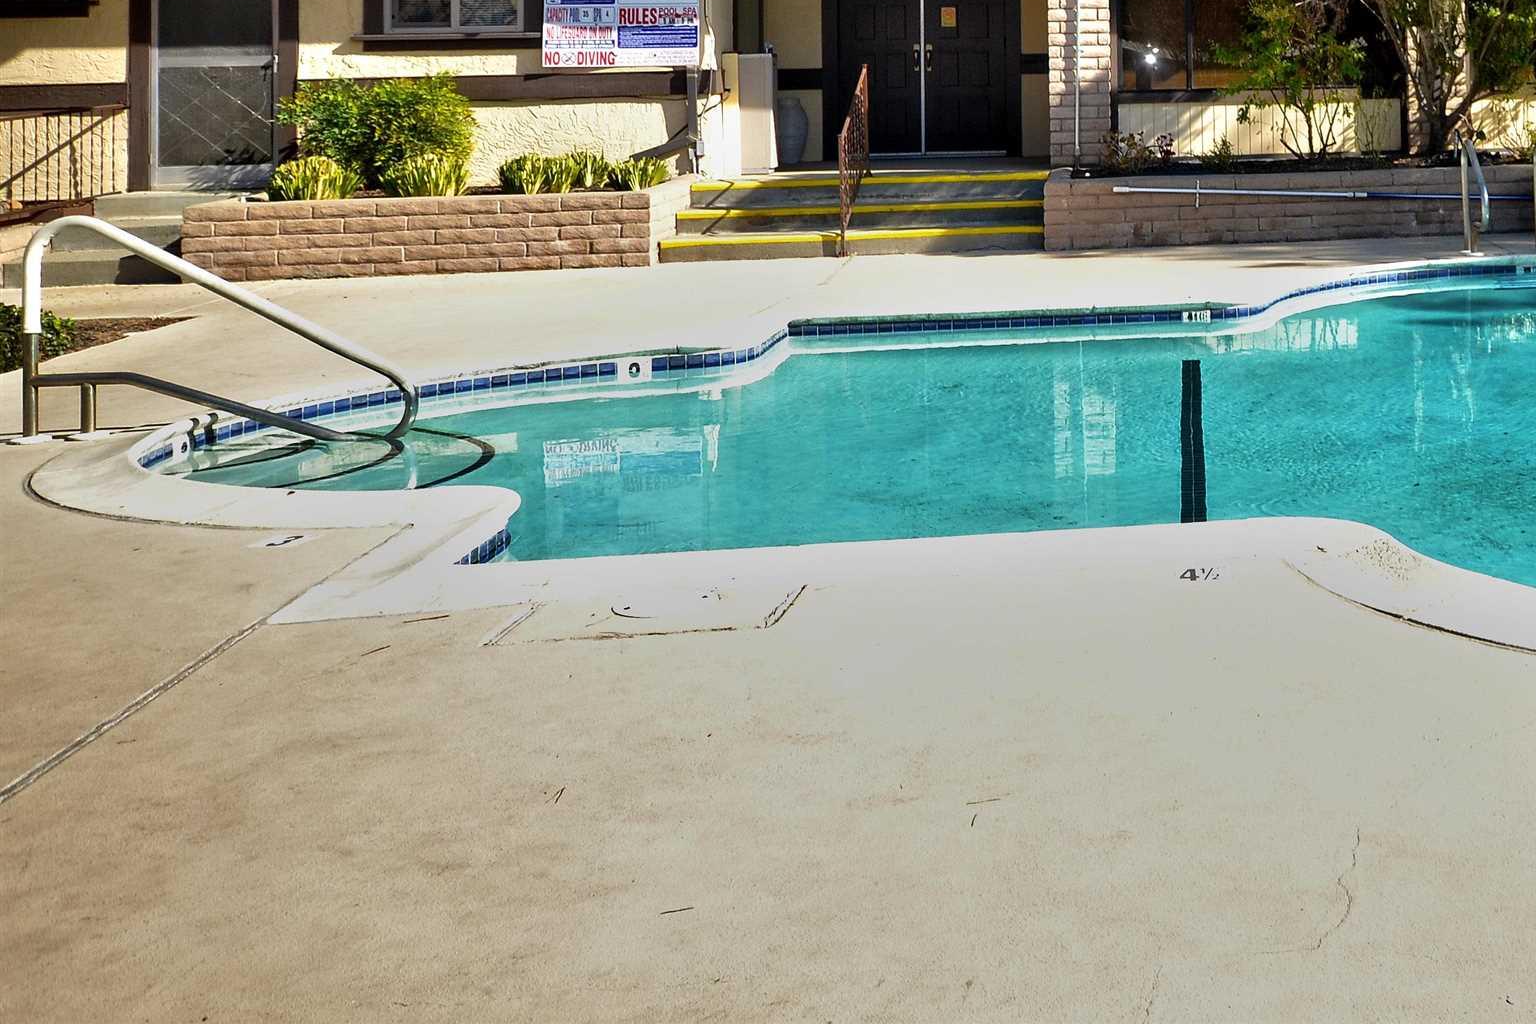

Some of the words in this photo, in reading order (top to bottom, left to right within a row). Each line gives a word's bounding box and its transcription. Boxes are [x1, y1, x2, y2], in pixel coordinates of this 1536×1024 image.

[618, 7, 658, 25] RULES
[546, 26, 555, 39] NO
[544, 51, 560, 65] NO
[577, 51, 616, 65] DIVING
